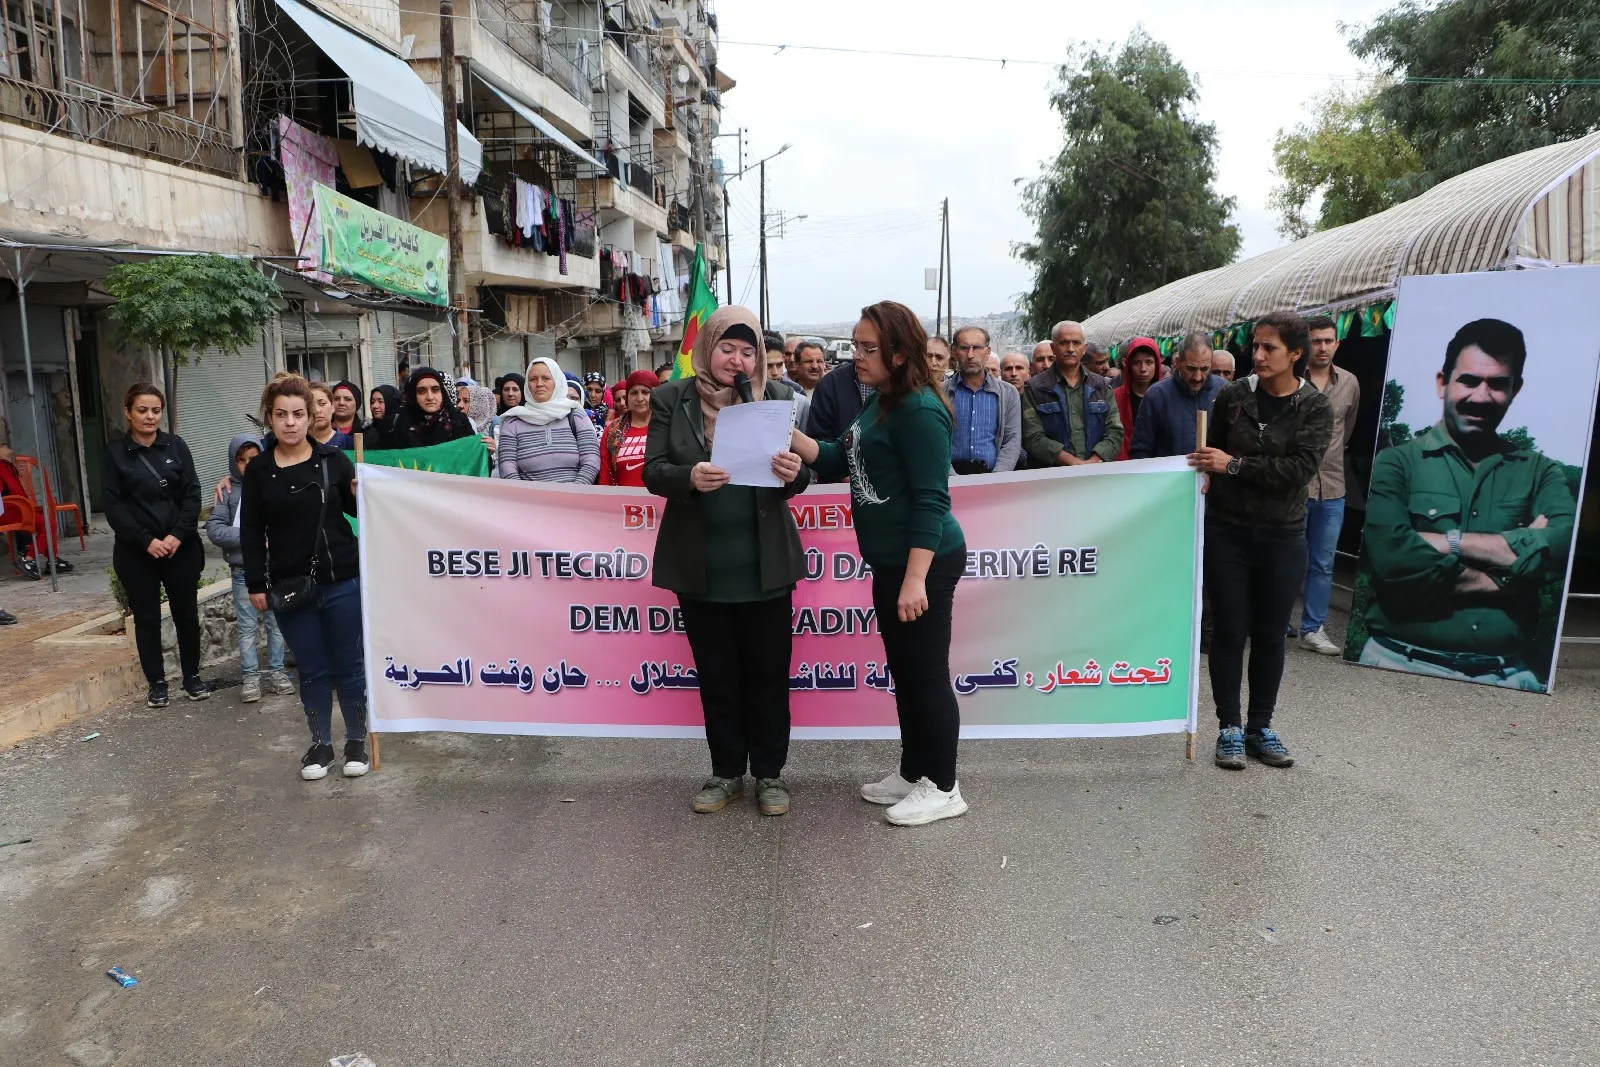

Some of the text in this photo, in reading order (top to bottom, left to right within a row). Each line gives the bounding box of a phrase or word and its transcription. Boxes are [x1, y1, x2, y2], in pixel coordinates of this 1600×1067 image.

[623, 504, 656, 529] BI
[427, 549, 501, 576] BESE
[507, 550, 531, 577] JI
[534, 547, 650, 580] TECRÎD
[961, 542, 1051, 578] ERIYÊ
[1057, 547, 1098, 576] RE
[569, 604, 640, 632] DEM
[647, 605, 687, 633] DE
[384, 655, 472, 690] الحرية
[480, 658, 535, 693] وقت
[541, 659, 588, 693] حان
[955, 657, 1019, 694] كفى
[1107, 657, 1171, 685] تحت
